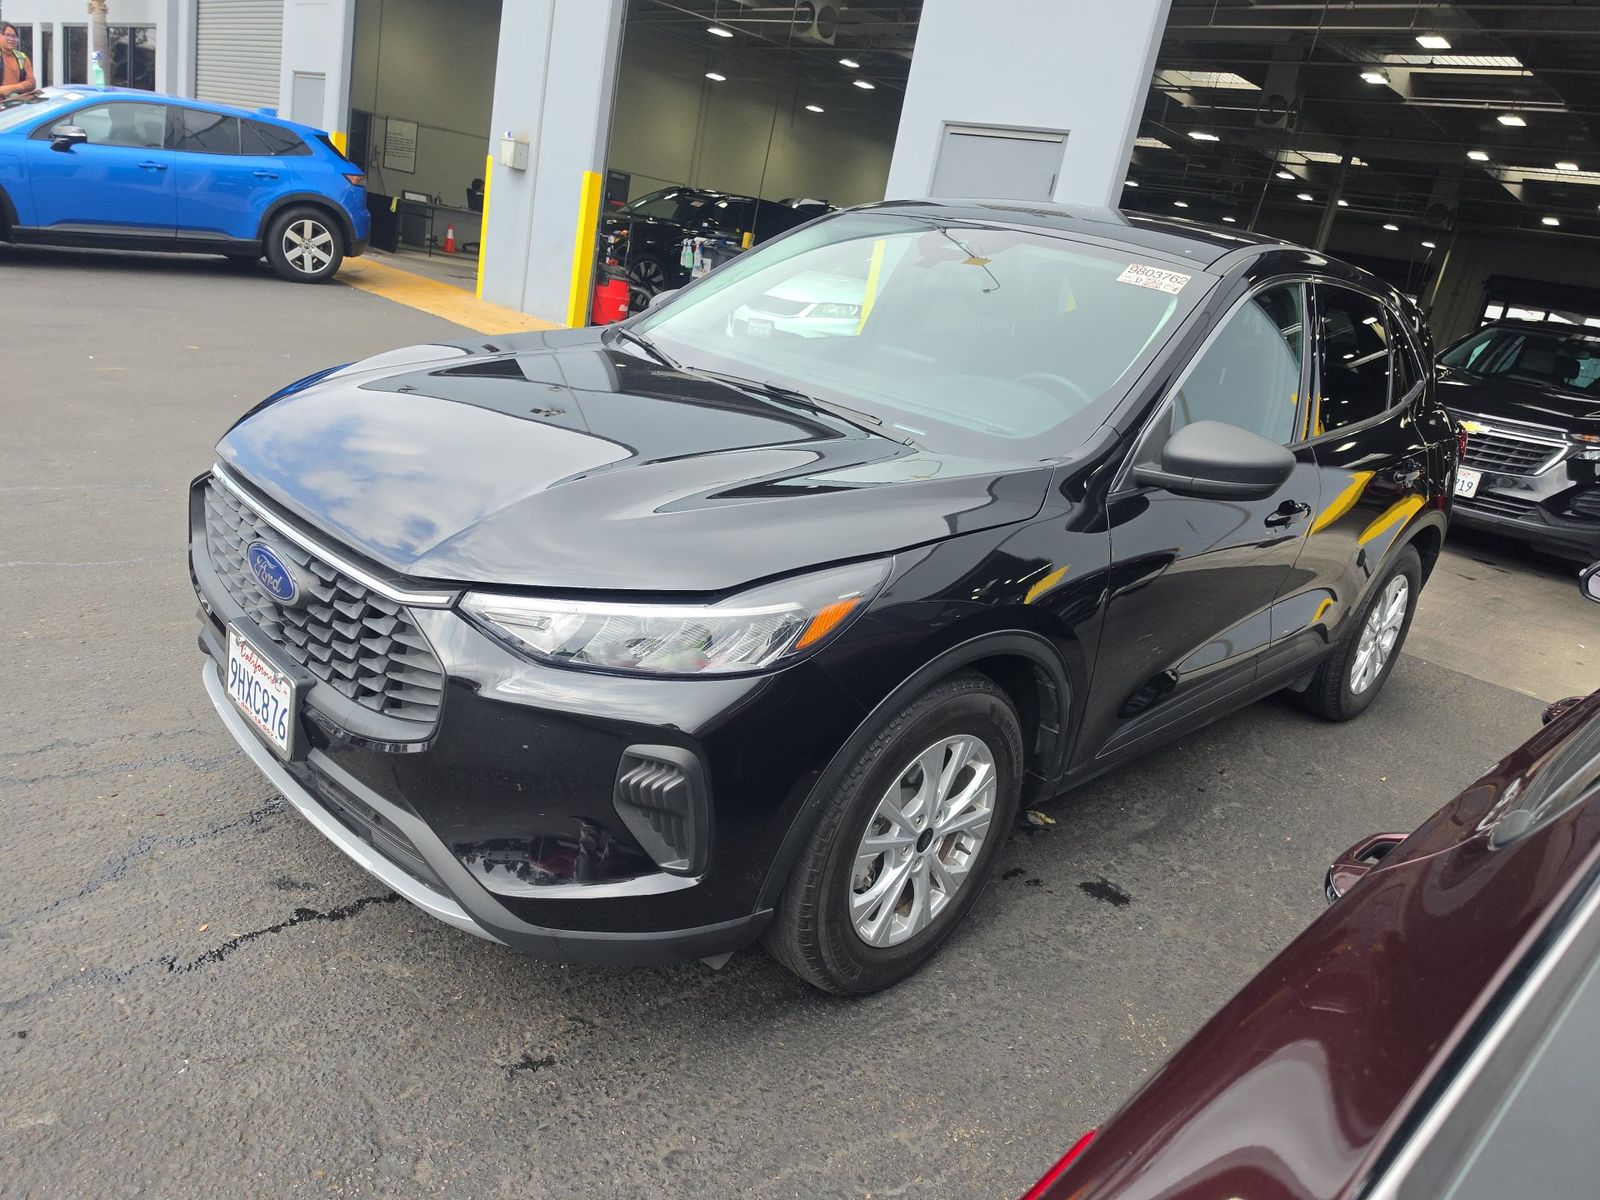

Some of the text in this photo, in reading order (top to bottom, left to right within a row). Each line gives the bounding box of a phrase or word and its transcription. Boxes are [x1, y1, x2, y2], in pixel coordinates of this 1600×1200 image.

[1128, 265, 1188, 285] 9803762
[254, 553, 282, 594] Ford
[230, 657, 288, 741] 9HXC876
